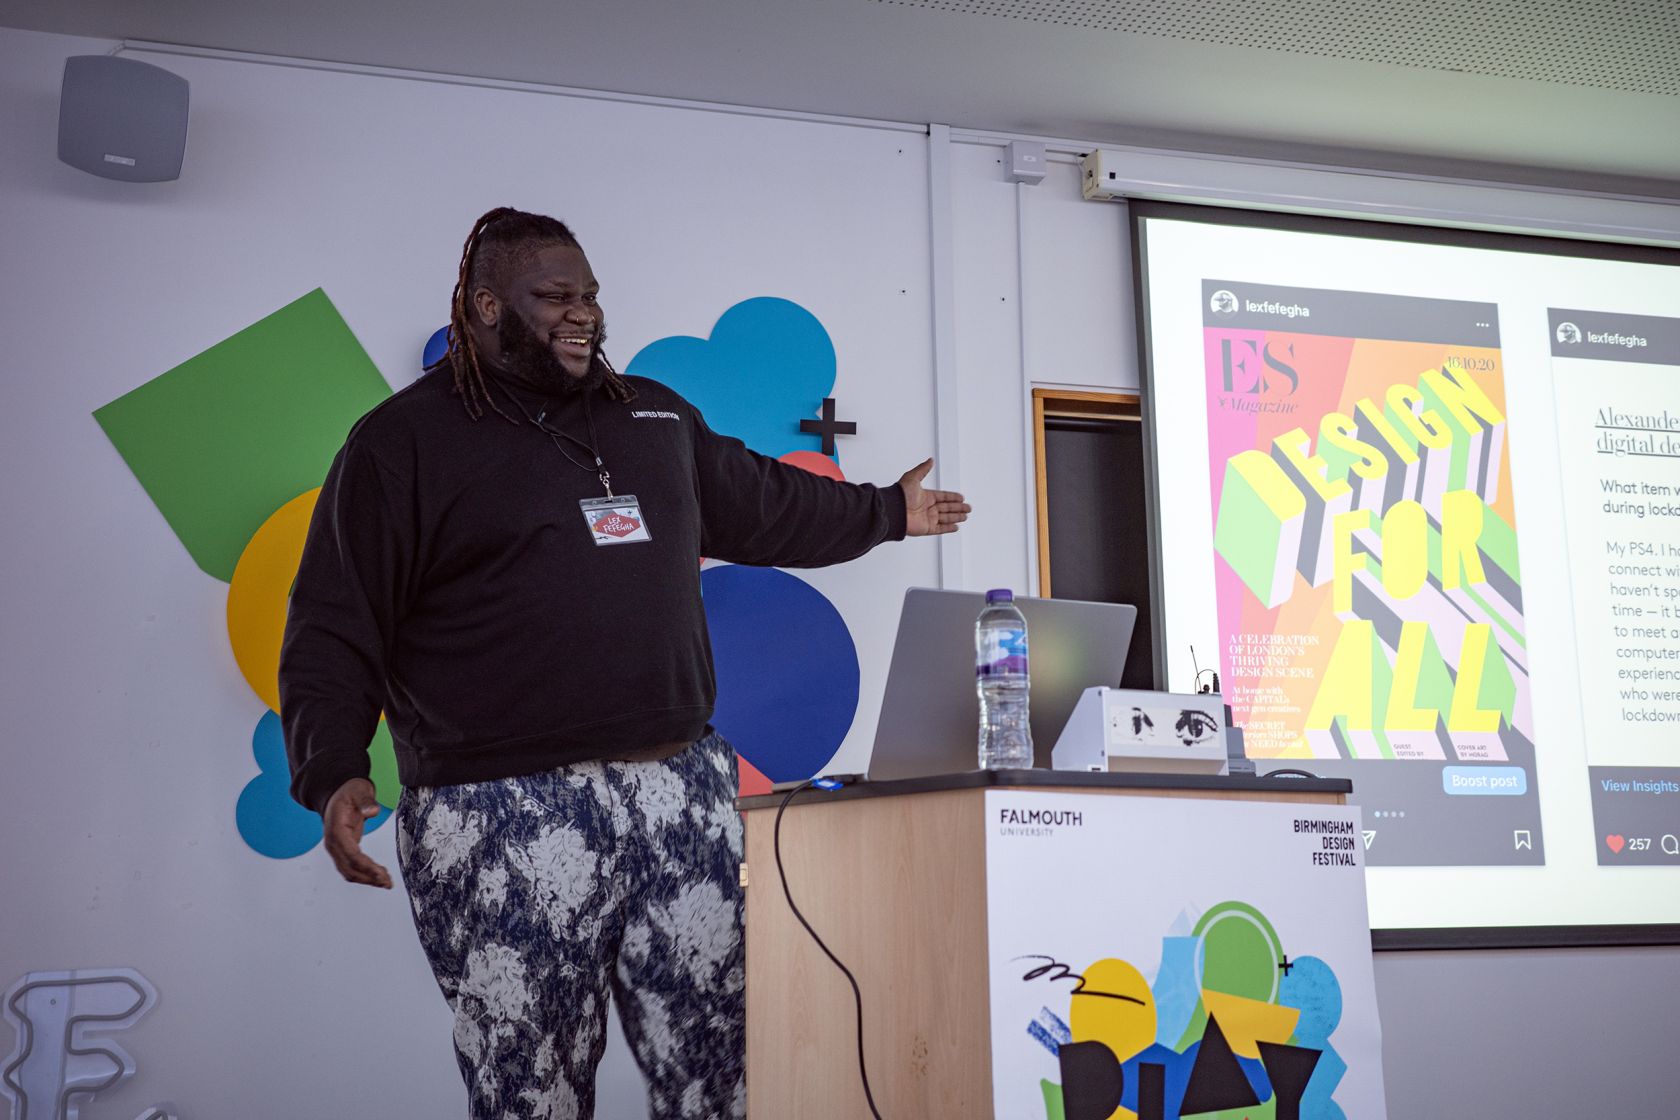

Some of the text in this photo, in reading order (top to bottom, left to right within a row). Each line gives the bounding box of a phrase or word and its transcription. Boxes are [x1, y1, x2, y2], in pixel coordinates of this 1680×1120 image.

[1246, 299, 1310, 318] lexfefegha
[1587, 331, 1647, 348] lexfefegha
[1221, 338, 1299, 396] ES
[1448, 356, 1495, 371] 16.10.20
[1231, 397, 1299, 416] Magazine
[657, 411, 680, 420] EDITION
[1227, 364, 1506, 523] DESIGN
[1597, 431, 1654, 457] digital
[1600, 479, 1638, 494] What
[1641, 481, 1670, 496] item
[1603, 499, 1645, 518] during
[608, 516, 621, 525] LEX
[1333, 489, 1487, 616] FOR
[1606, 541, 1626, 559] My
[1630, 541, 1658, 556] PS4.
[1609, 565, 1661, 577] connect
[1610, 582, 1660, 597] haven't
[1612, 603, 1642, 616] time
[1661, 604, 1671, 618] it
[1614, 625, 1628, 637] to
[1632, 627, 1667, 639] meet
[1229, 634, 1320, 646] A CELEBRATION
[1229, 645, 1244, 655] OF
[1229, 655, 1289, 667] THRIVING
[1231, 667, 1315, 679] DESIGN SCENE
[1304, 620, 1502, 732] ALL
[1620, 687, 1649, 701] who
[1452, 774, 1518, 789] Boost post
[1601, 779, 1680, 795] View Insights
[1000, 808, 1082, 827] FALMOUTH
[1000, 827, 1054, 837] UNIVERSITY
[1294, 819, 1354, 835] BIRMINGHAM
[1322, 836, 1355, 851] DESIGN
[1628, 838, 1651, 851] 257
[1313, 852, 1356, 867] FESTIVAL
